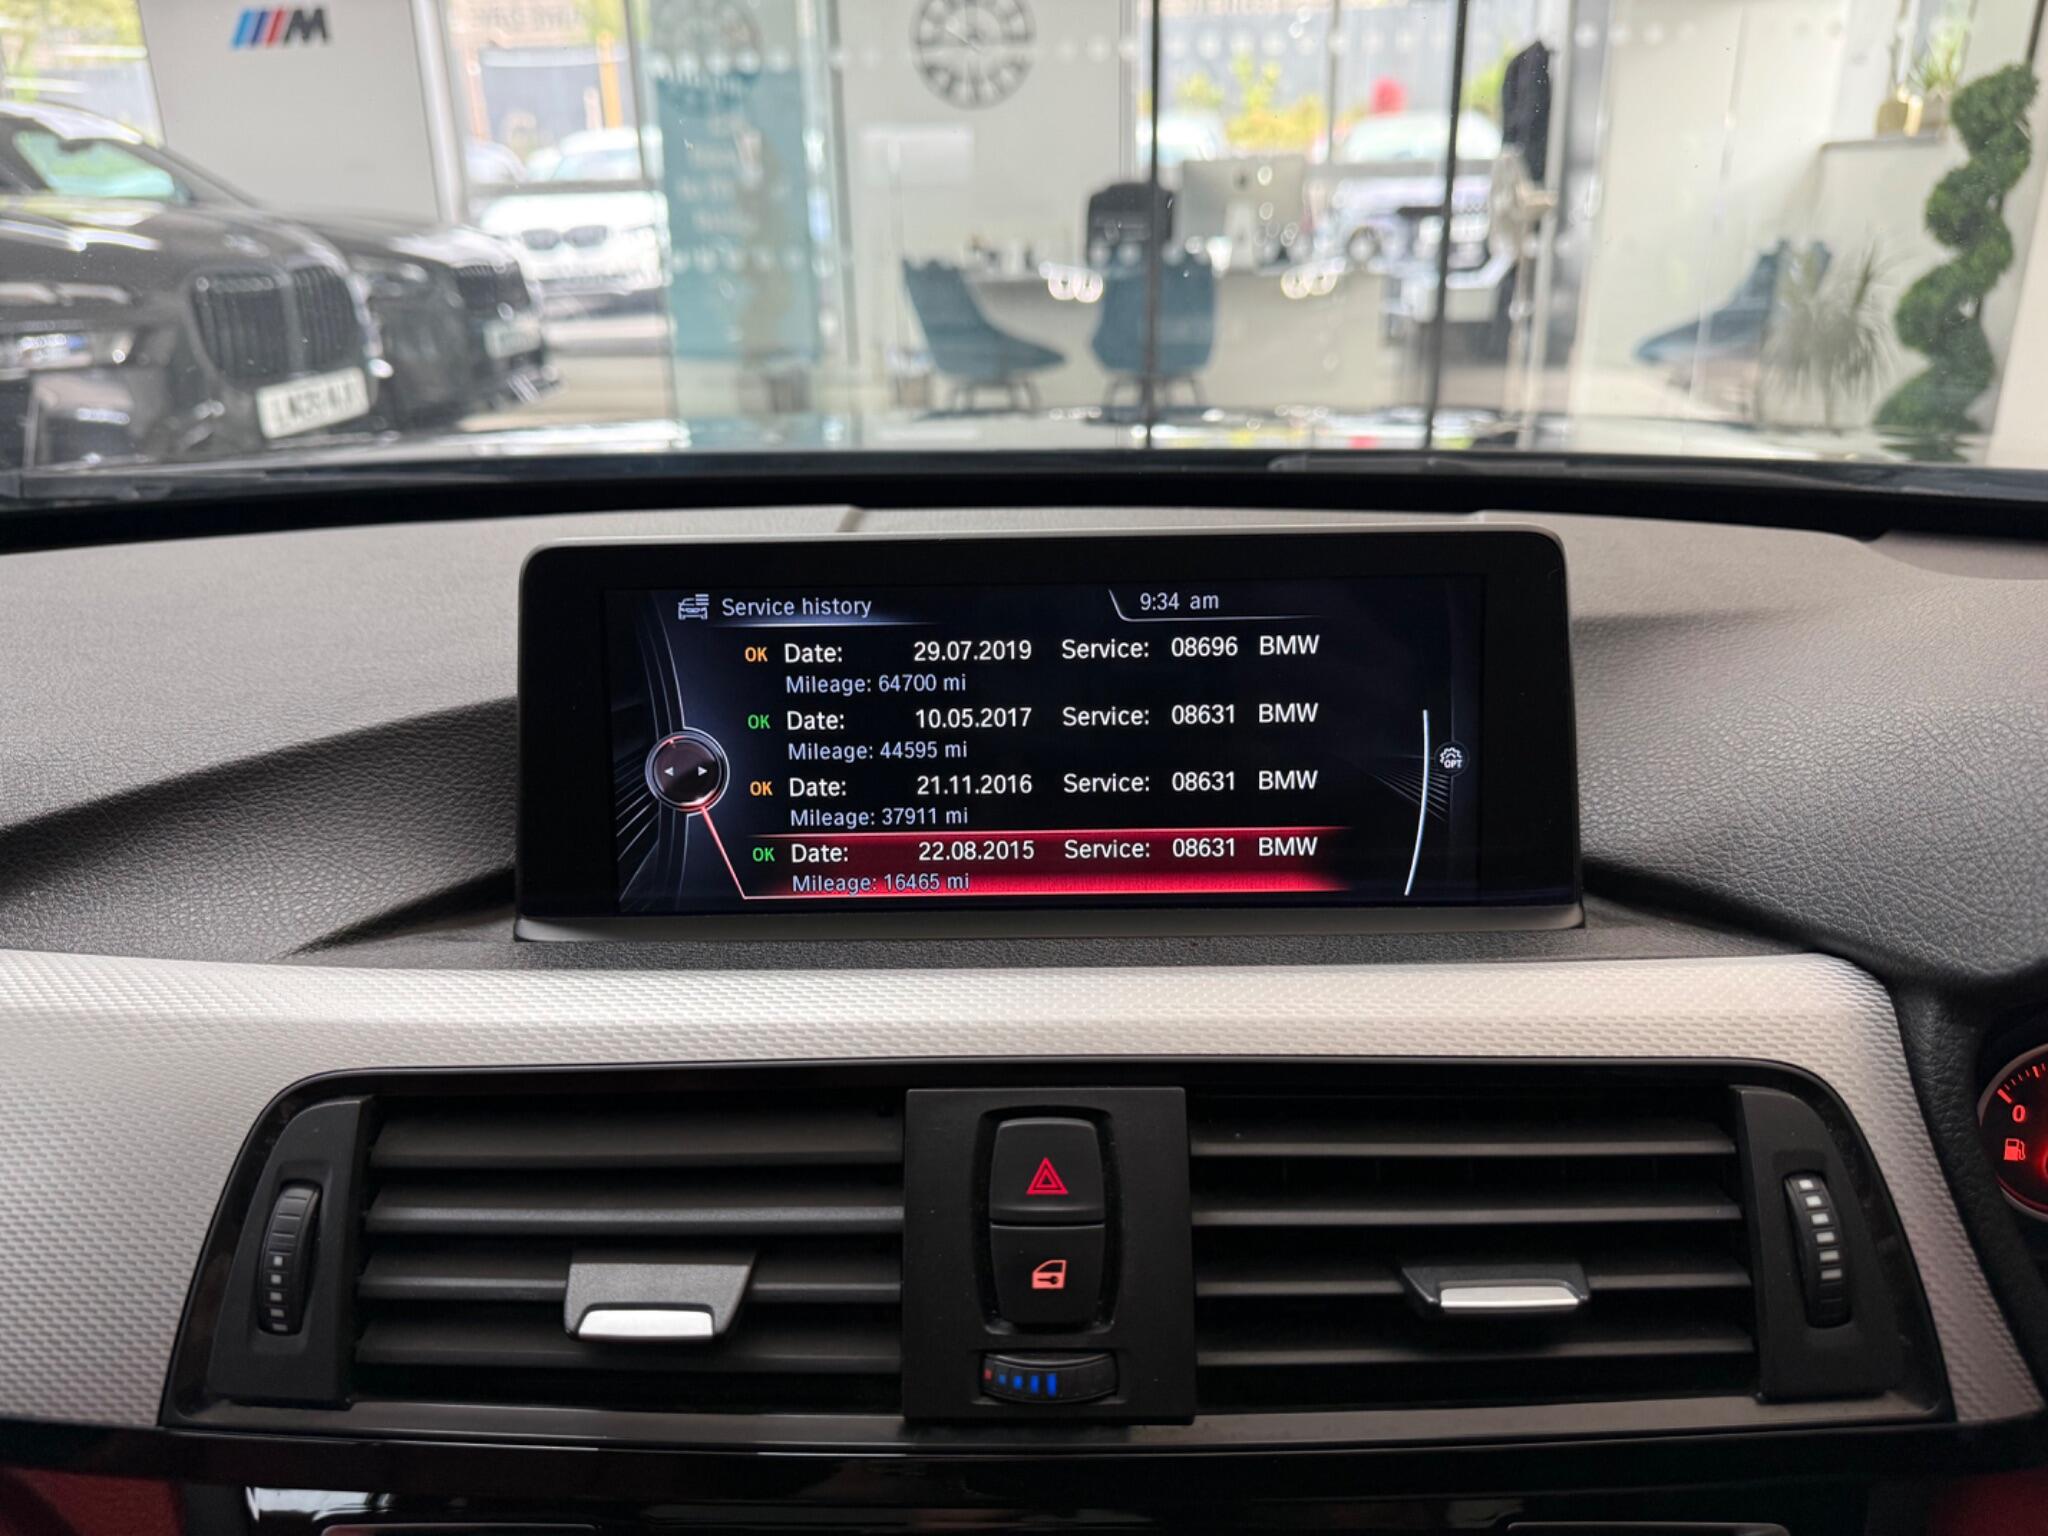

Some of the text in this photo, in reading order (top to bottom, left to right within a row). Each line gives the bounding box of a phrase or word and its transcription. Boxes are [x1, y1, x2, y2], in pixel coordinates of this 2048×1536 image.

[721, 597, 872, 618] Service history
[1139, 591, 1219, 611] 9:34 am
[744, 634, 1320, 663] OK Date: 29.07.2019 Service: 08696 BMW
[785, 673, 966, 697] Mileage: 64700 mi
[747, 702, 1319, 731] OK Date: 10.05.2017 Service: 08631 BMW
[788, 740, 968, 764] Mileage: 44595 mi
[1444, 759, 1463, 769] OPT
[749, 769, 1319, 797] OK Date: 21.11.2016 Service: 08631 BMW
[789, 806, 968, 830] Mileage: 37911 mi
[752, 836, 1319, 863] OK Date: 22.08.2015 Service: 08631 BMW
[792, 873, 971, 895] Mileage: 16465 mi
[2012, 1104, 2026, 1122] 0
